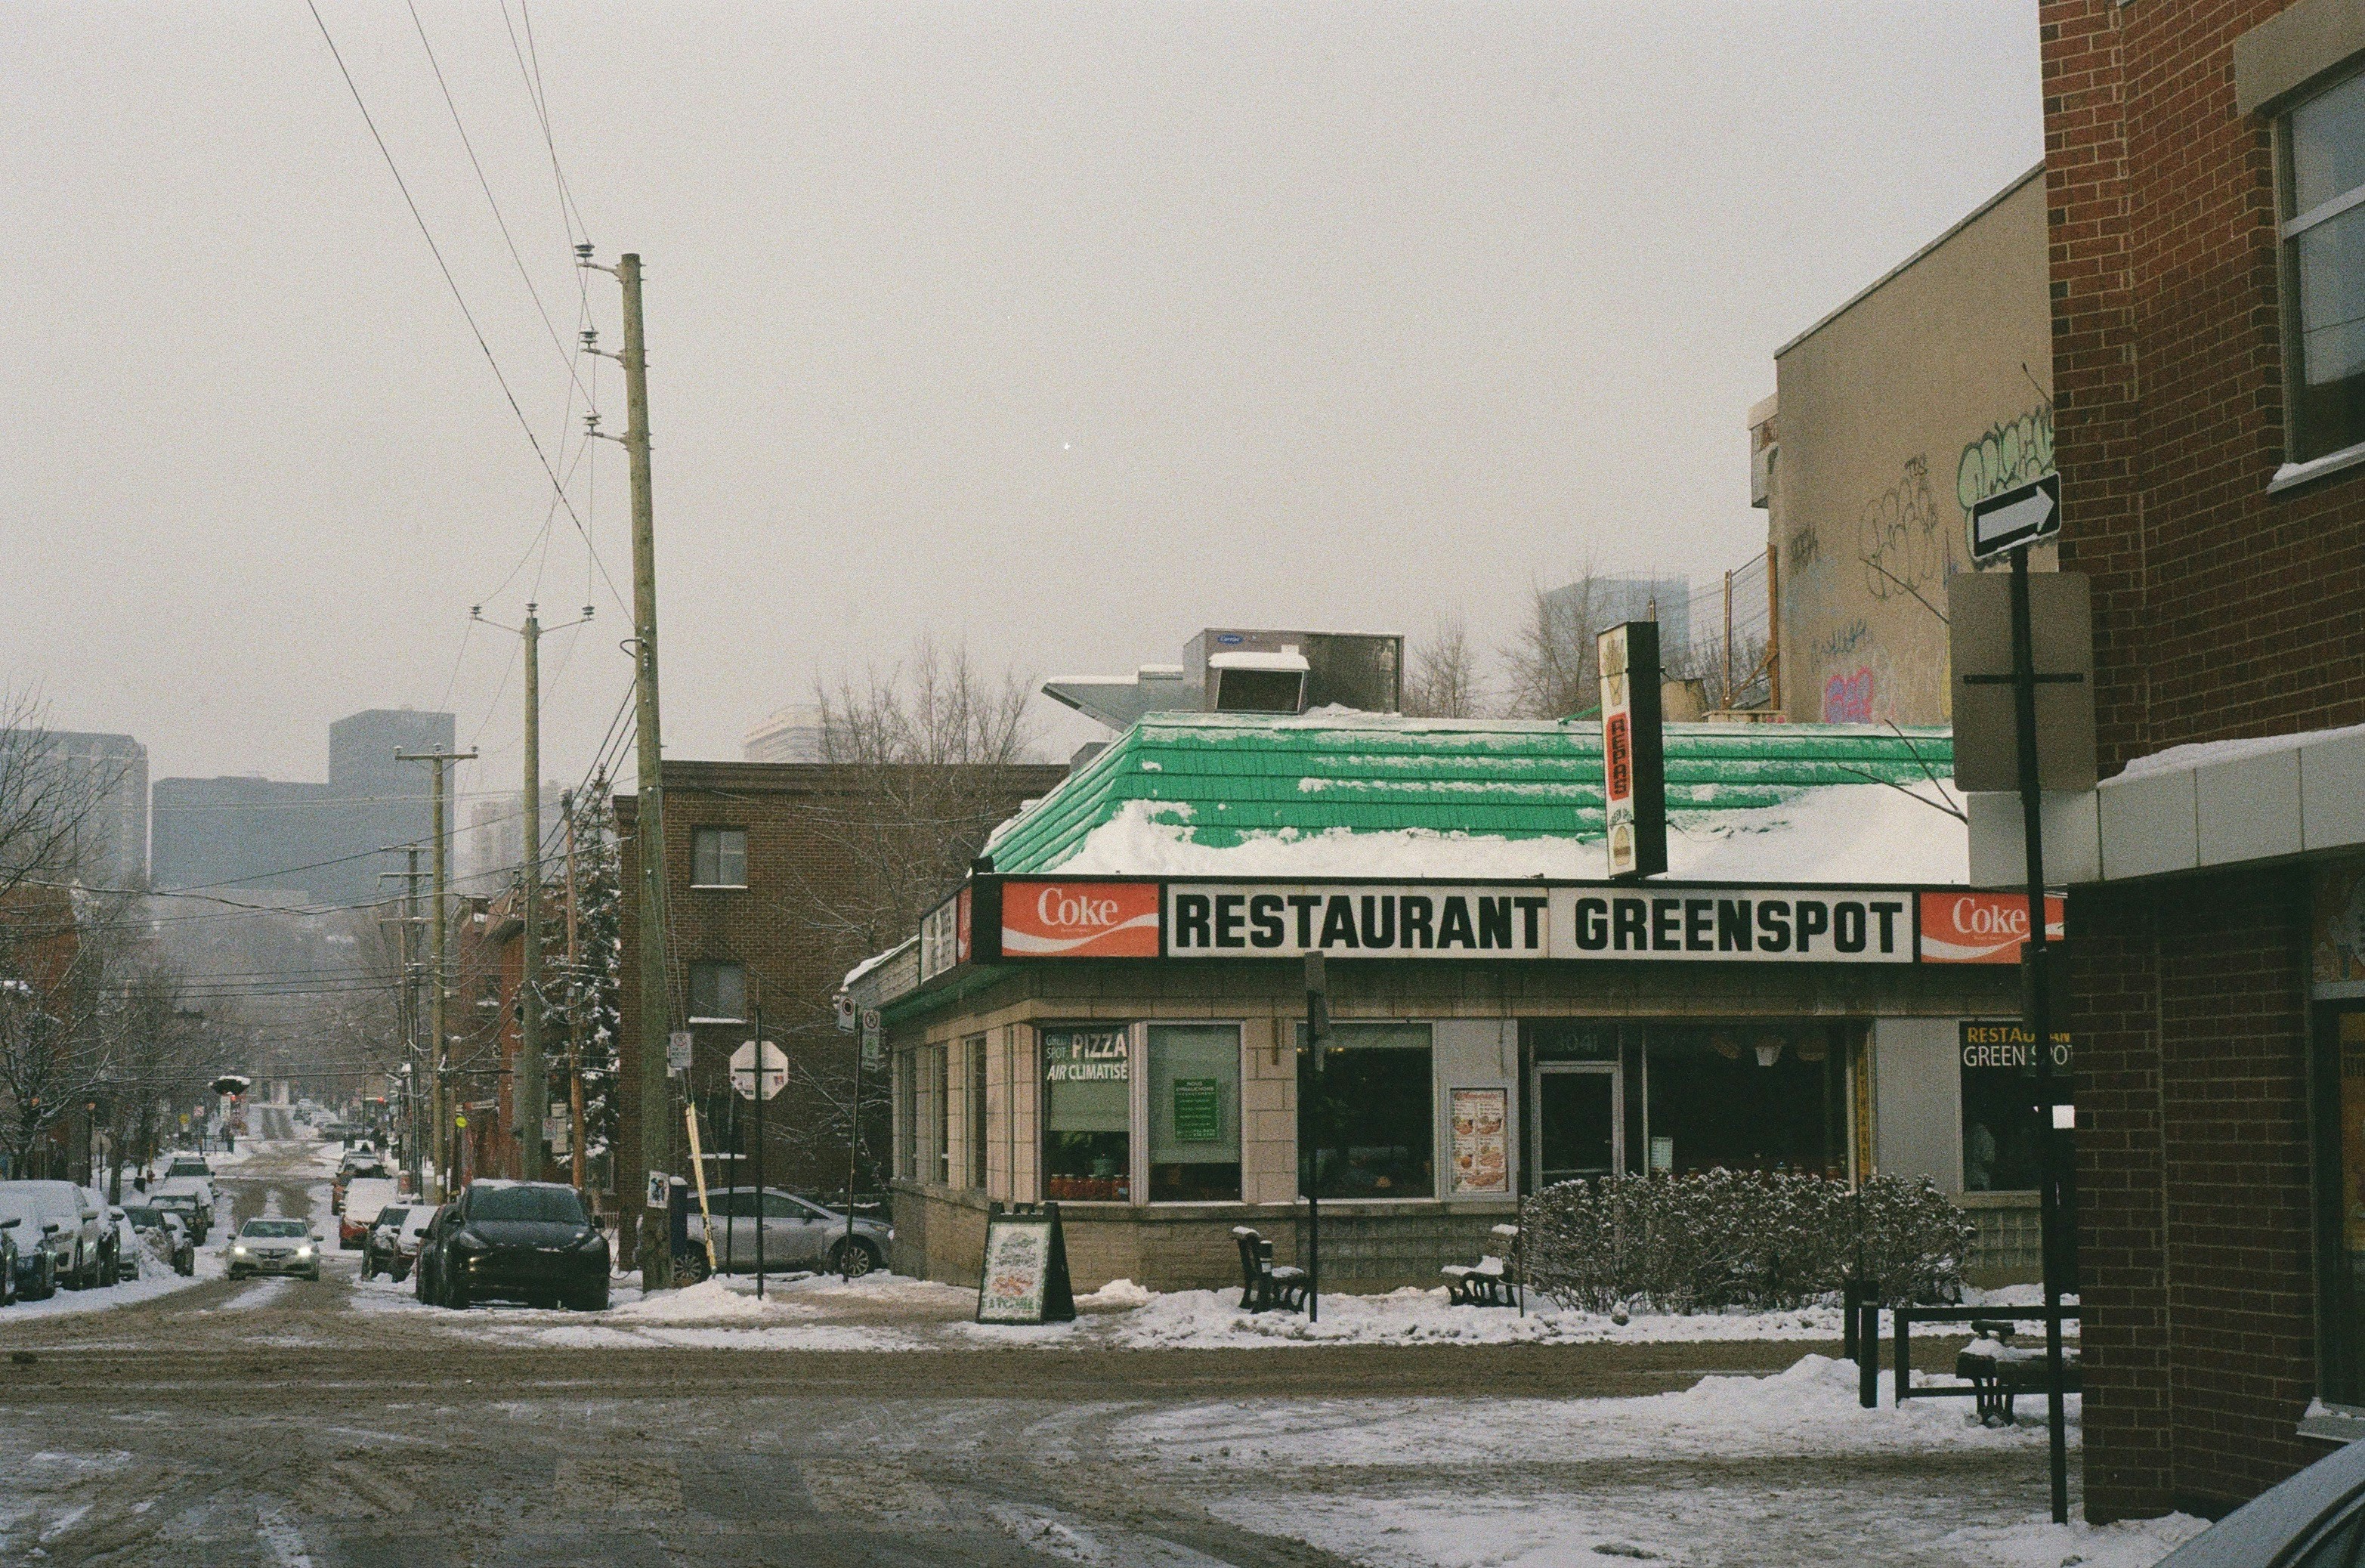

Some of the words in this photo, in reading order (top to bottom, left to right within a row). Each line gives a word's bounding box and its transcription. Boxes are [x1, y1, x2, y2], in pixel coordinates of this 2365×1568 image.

[1611, 719, 1628, 795] REPAS
[1037, 887, 1119, 926] Coke
[1952, 897, 2026, 934] Coke
[1176, 894, 1548, 949] RESTAURANT
[1575, 897, 1903, 954] GREENSPOT
[1071, 1033, 1128, 1059] PIZZA
[1968, 1027, 2070, 1043] RESTAUAN
[1046, 1064, 1067, 1081] AIR
[1068, 1059, 1128, 1080] CLIMATISÉ
[1964, 1045, 2026, 1066] GREEN
